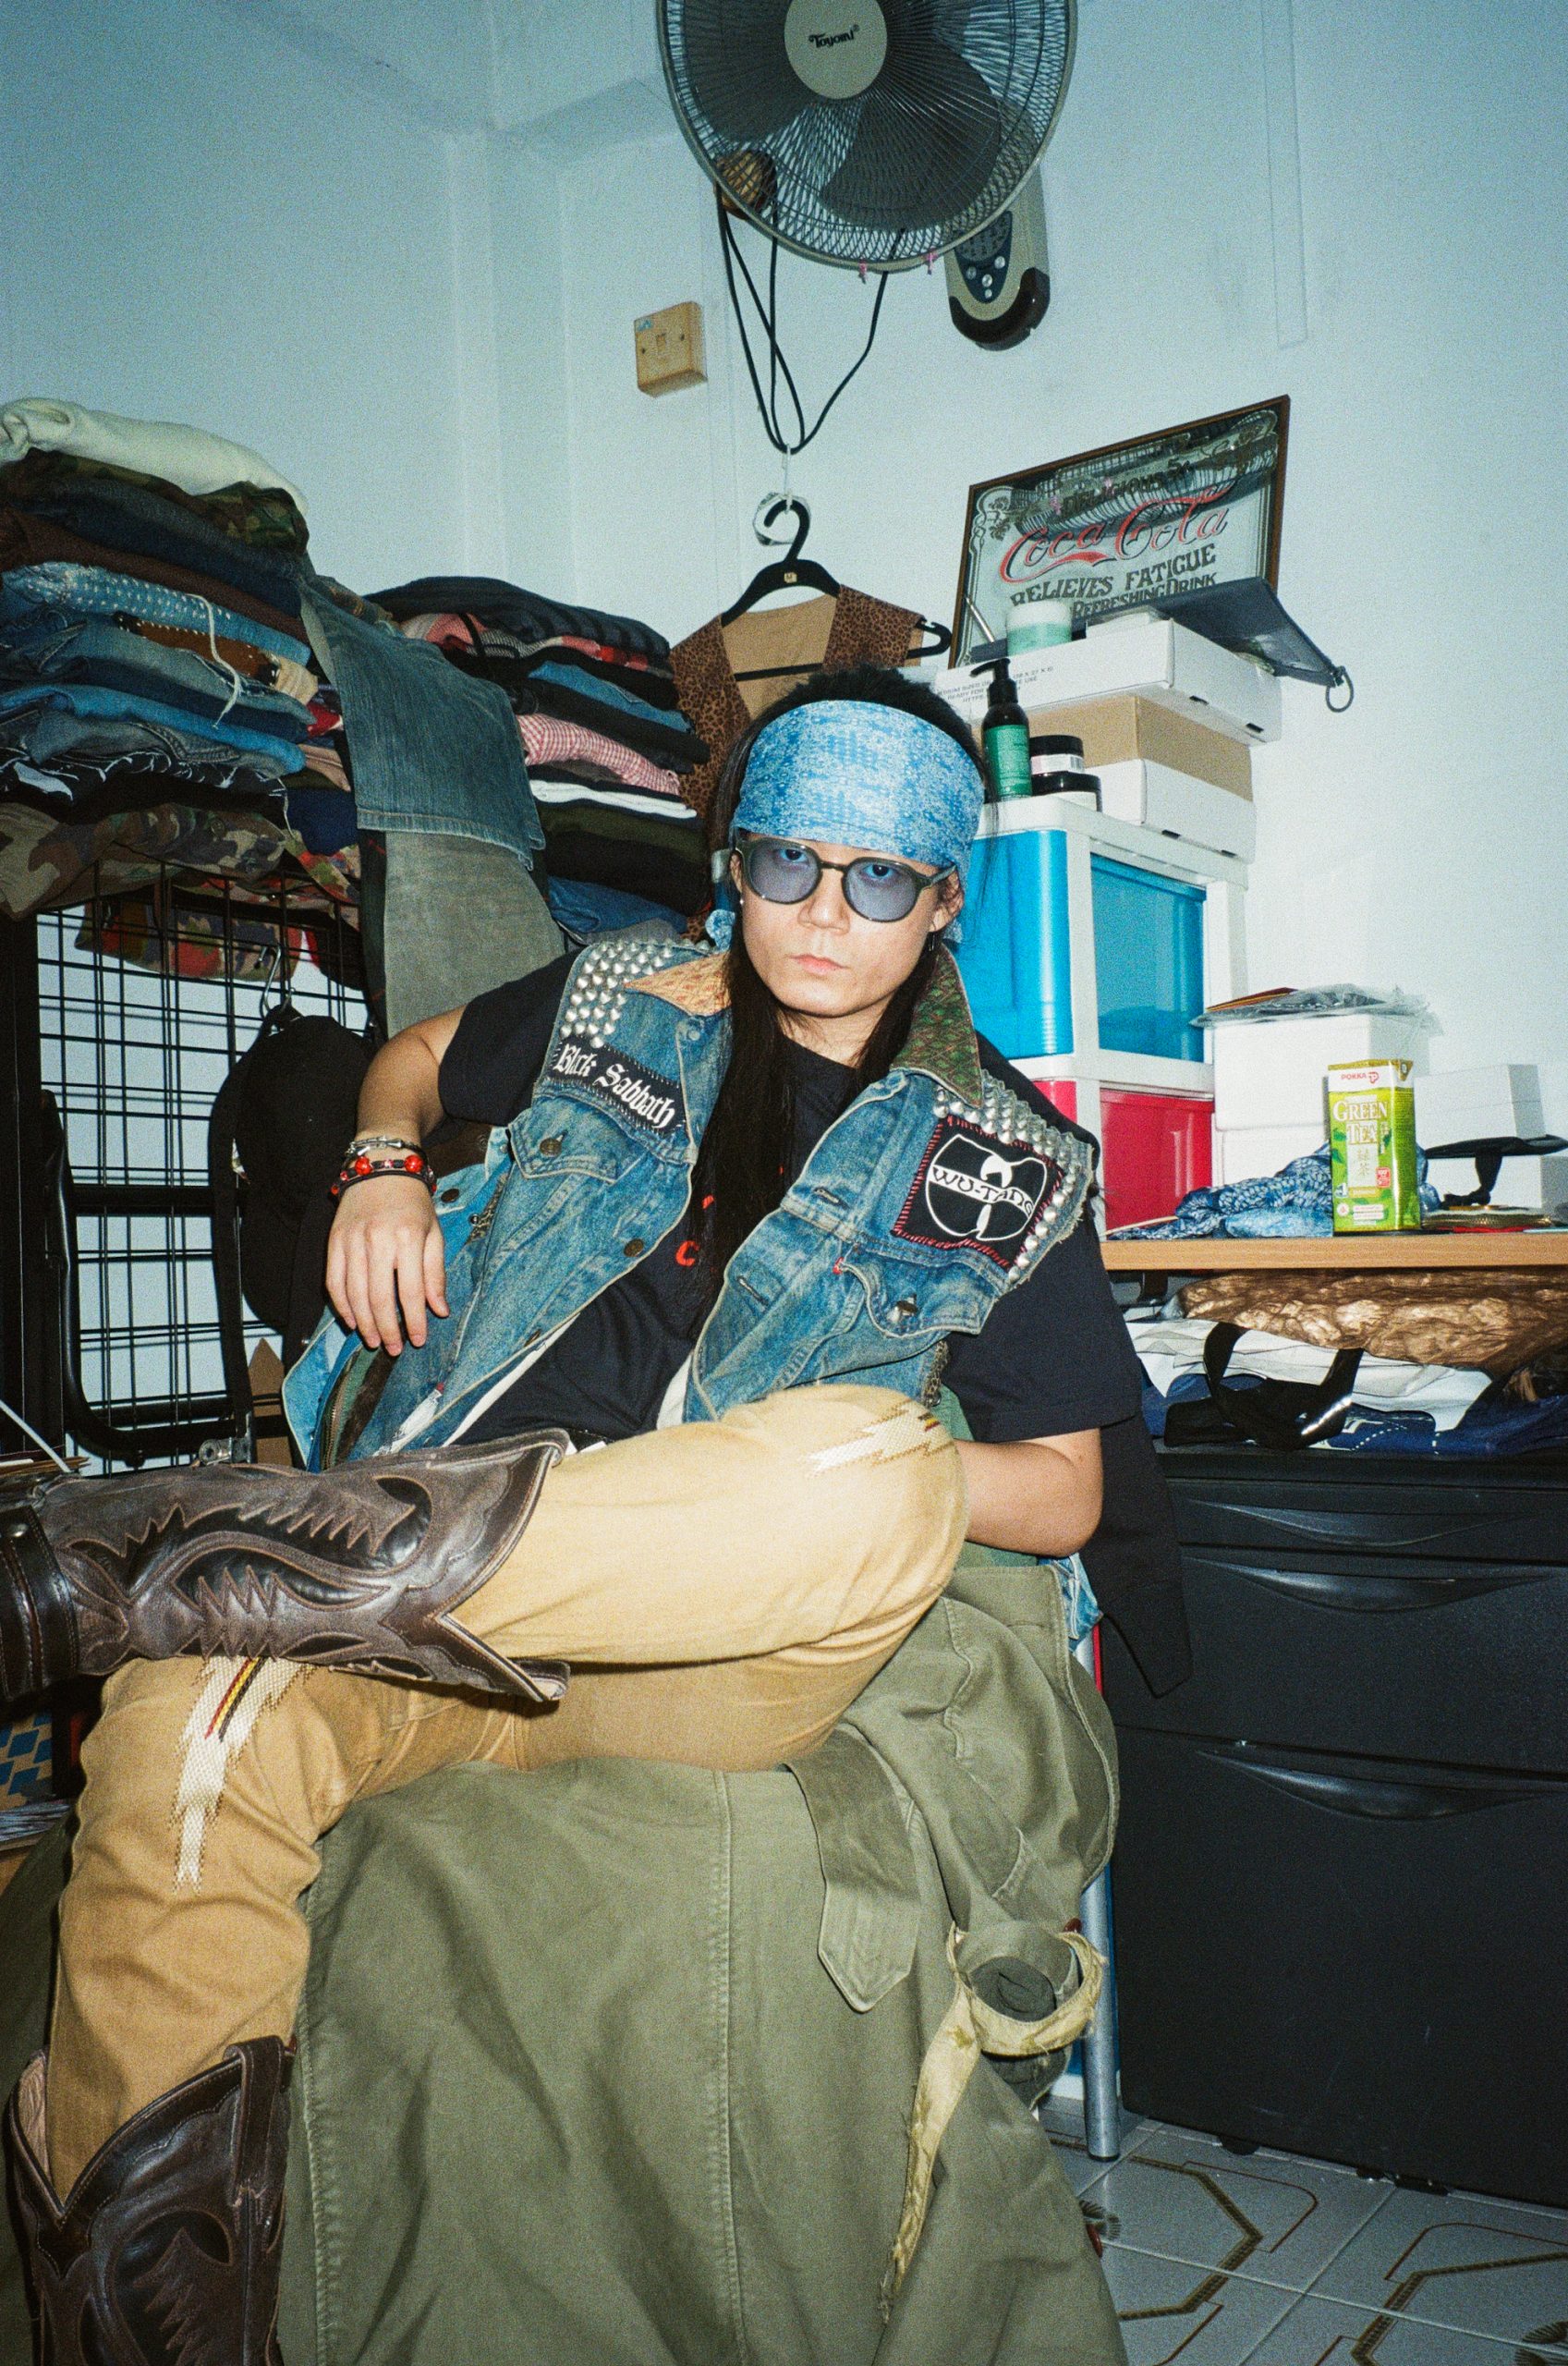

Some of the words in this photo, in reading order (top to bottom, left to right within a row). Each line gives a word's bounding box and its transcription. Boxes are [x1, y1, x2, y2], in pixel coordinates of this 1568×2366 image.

[1009, 576, 1113, 606] RELIEVES
[1124, 543, 1216, 591] FATIGUE
[1165, 571, 1218, 597] DRINK
[1341, 1072, 1367, 1080] POKKA
[592, 1063, 675, 1128] Sabbath
[1332, 1099, 1389, 1123] GREEN
[1346, 1122, 1379, 1145] TEA
[931, 1165, 1036, 1216] WU-TANG
